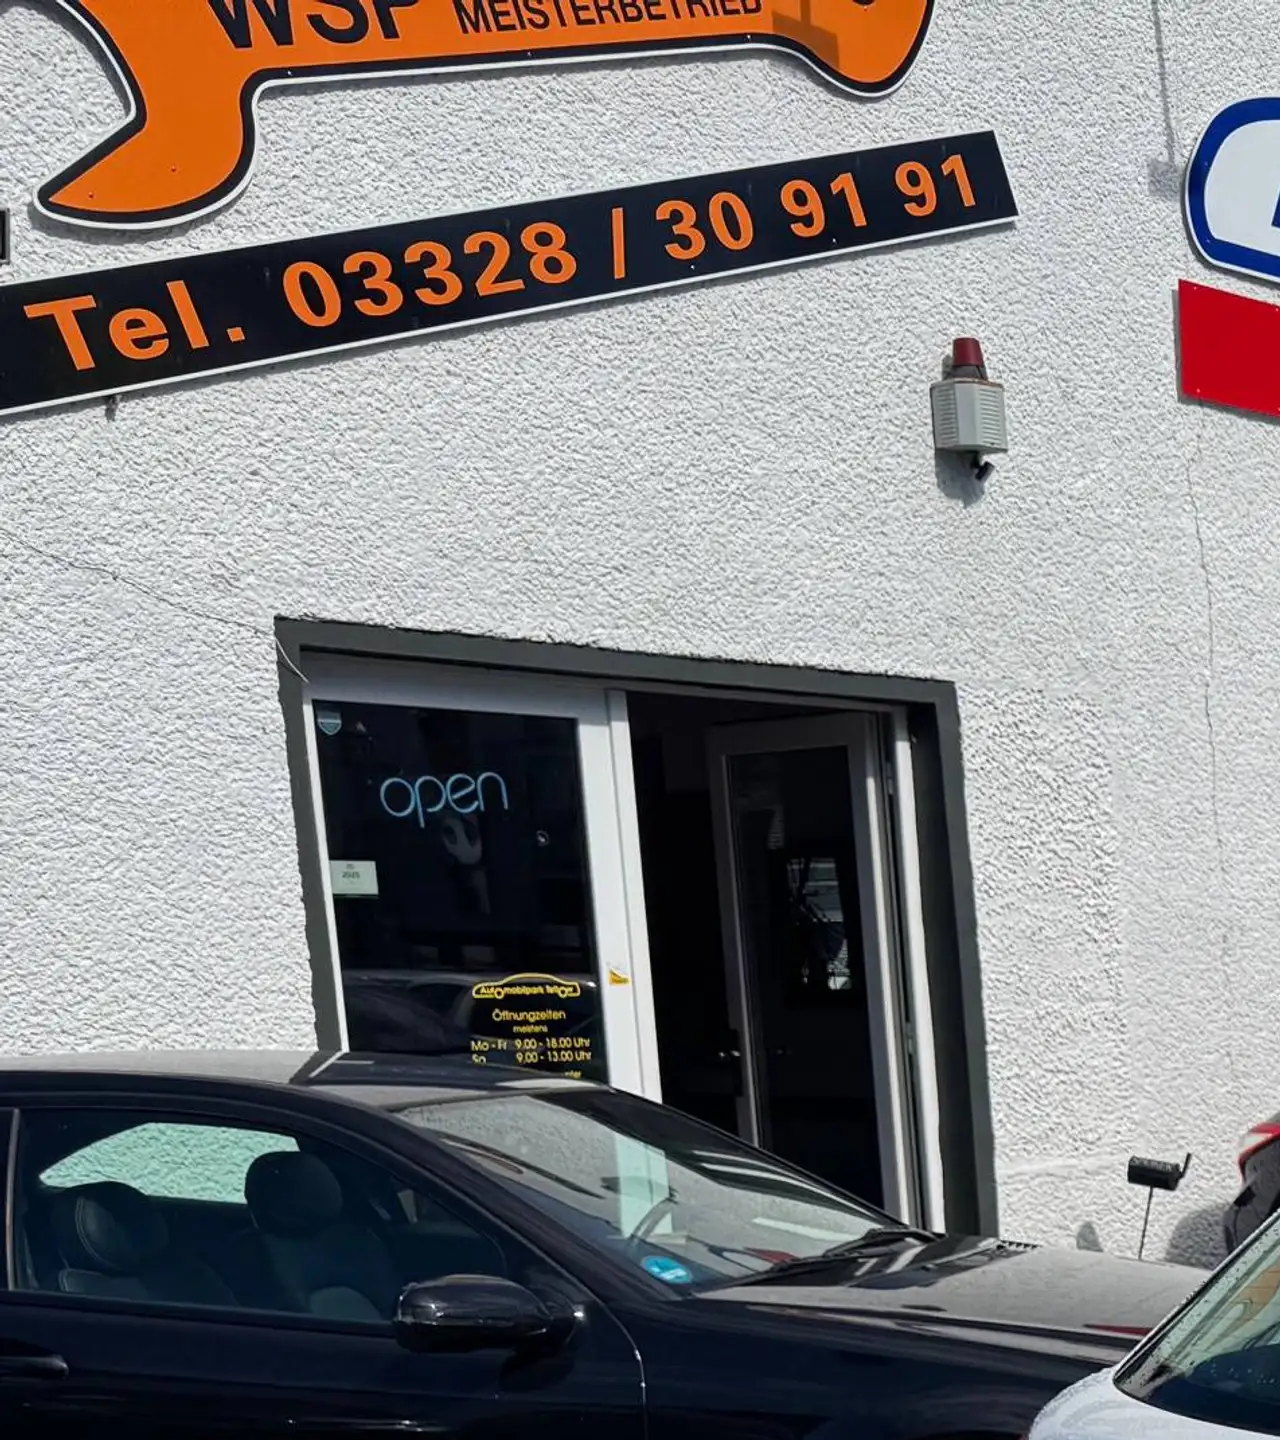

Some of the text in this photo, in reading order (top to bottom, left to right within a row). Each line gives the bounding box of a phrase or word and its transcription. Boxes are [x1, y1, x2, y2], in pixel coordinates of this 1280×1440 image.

[25, 155, 975, 370] Tel. 03328 / 30 91 91
[380, 772, 508, 828] open
[471, 1040, 489, 1051] Mo
[573, 1037, 590, 1048] Uhr
[575, 1050, 591, 1061] Uhr
